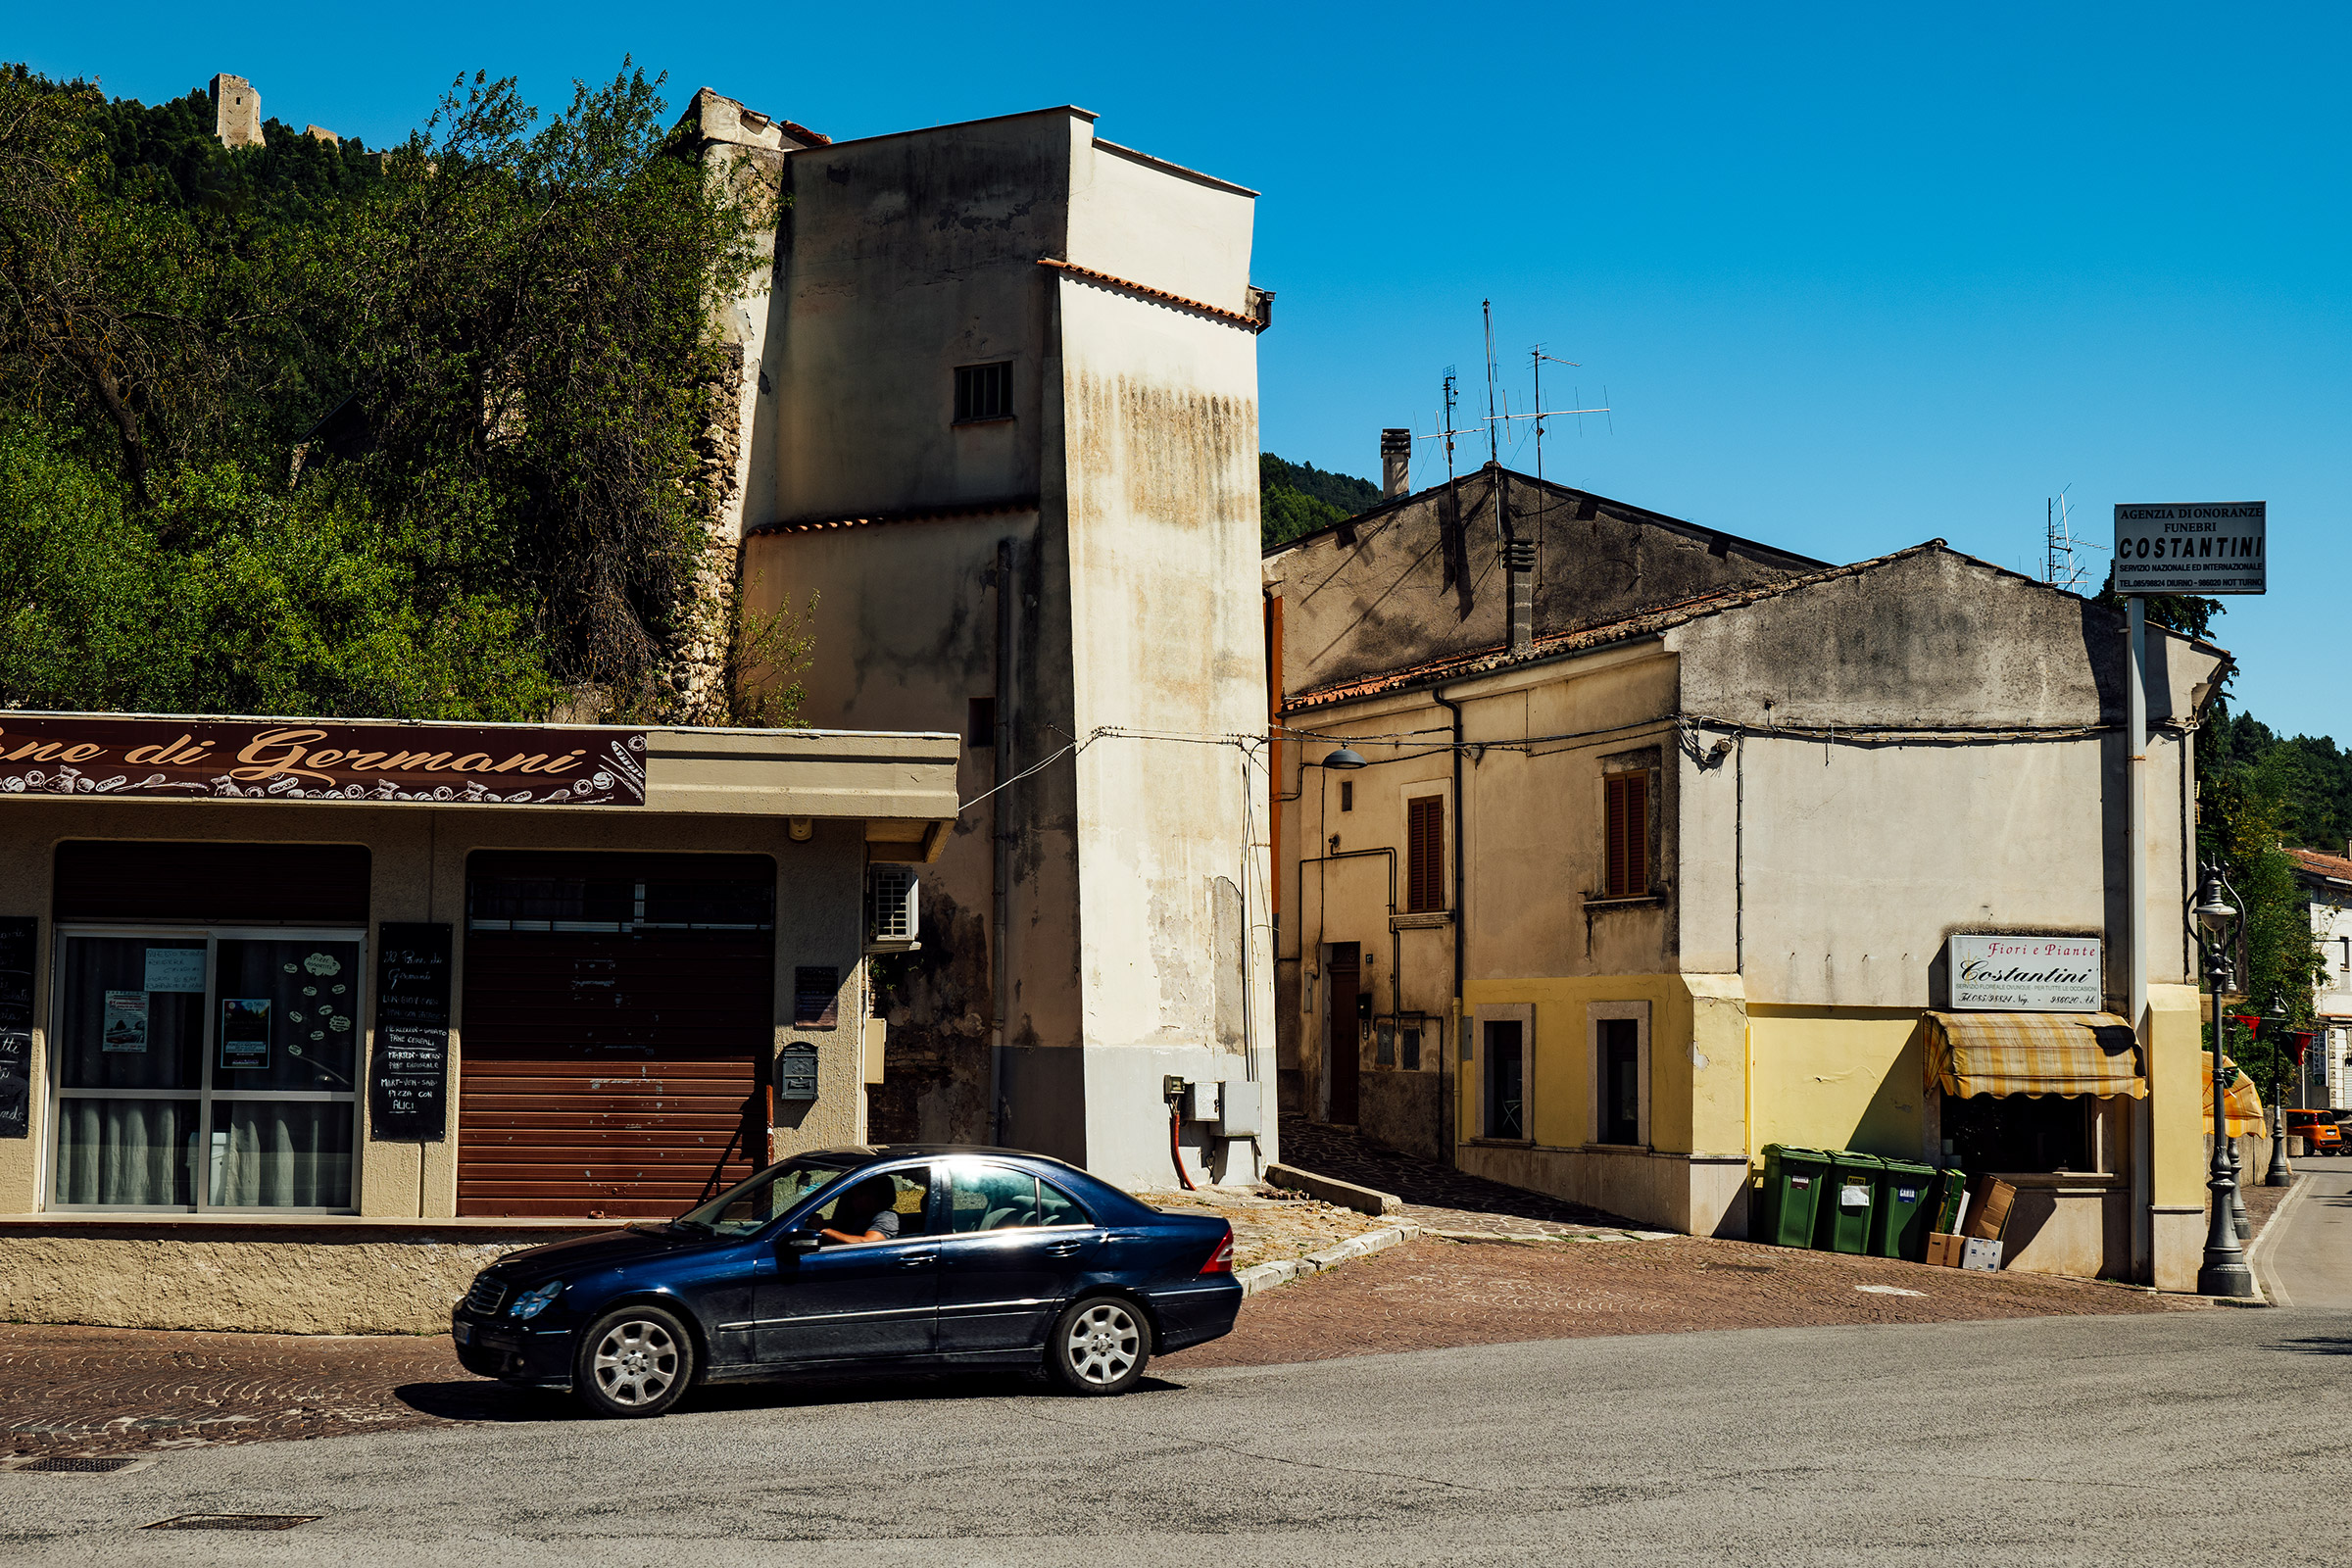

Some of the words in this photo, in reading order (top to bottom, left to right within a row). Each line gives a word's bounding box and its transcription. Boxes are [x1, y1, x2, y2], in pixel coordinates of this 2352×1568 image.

[2120, 509, 2174, 520] AGENZIA
[2179, 509, 2191, 518] DI
[2194, 507, 2263, 518] ONORANZE
[2164, 521, 2217, 533] FUNEBRI
[2119, 536, 2262, 559] COSTANTINI
[2203, 563, 2263, 571] INTERNAZIONALE
[123, 733, 217, 764] di
[228, 728, 587, 787] Germani
[1987, 942, 2028, 957] Fiori
[2033, 947, 2039, 956] e
[2044, 944, 2095, 956] Piante
[1960, 959, 2092, 983] Costantini
[388, 1089, 413, 1098] PIZZA
[392, 1099, 415, 1110] ALICI
